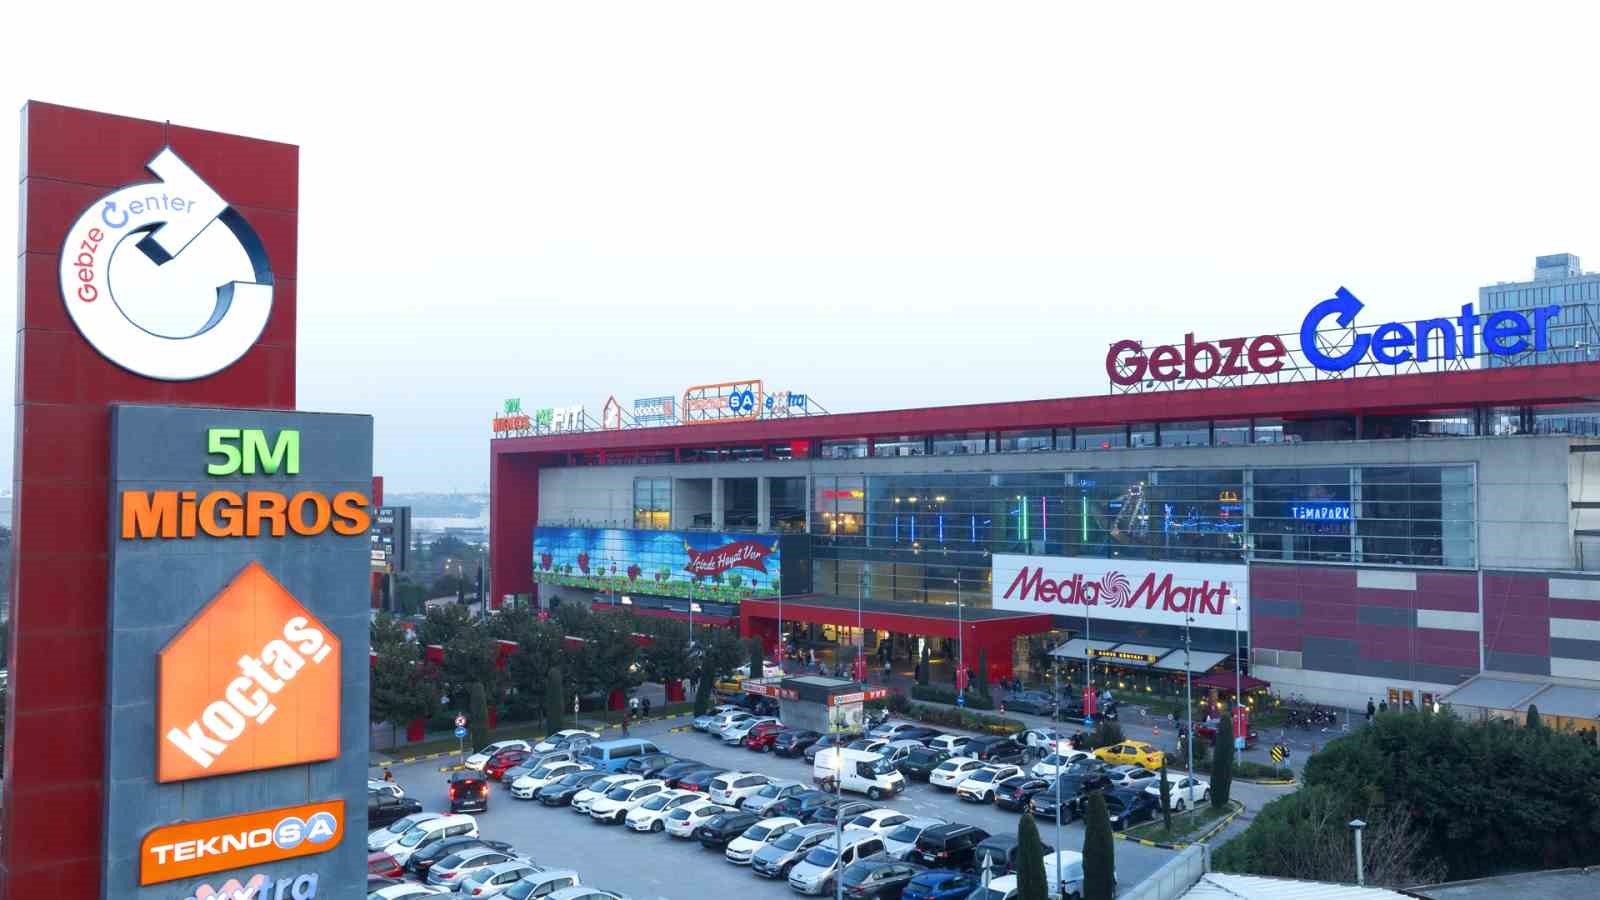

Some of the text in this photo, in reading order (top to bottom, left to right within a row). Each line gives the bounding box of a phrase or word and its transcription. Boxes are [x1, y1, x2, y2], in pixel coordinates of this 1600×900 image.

[73, 192, 196, 303] Gebze Center
[1105, 286, 1560, 387] Gebze Center
[207, 428, 302, 476] 5M
[717, 548, 743, 568] Hayat
[743, 545, 761, 561] Var
[1003, 566, 1230, 615] Media Markt
[166, 615, 332, 768] koçtaş
[151, 814, 336, 865] TEKNOSA
